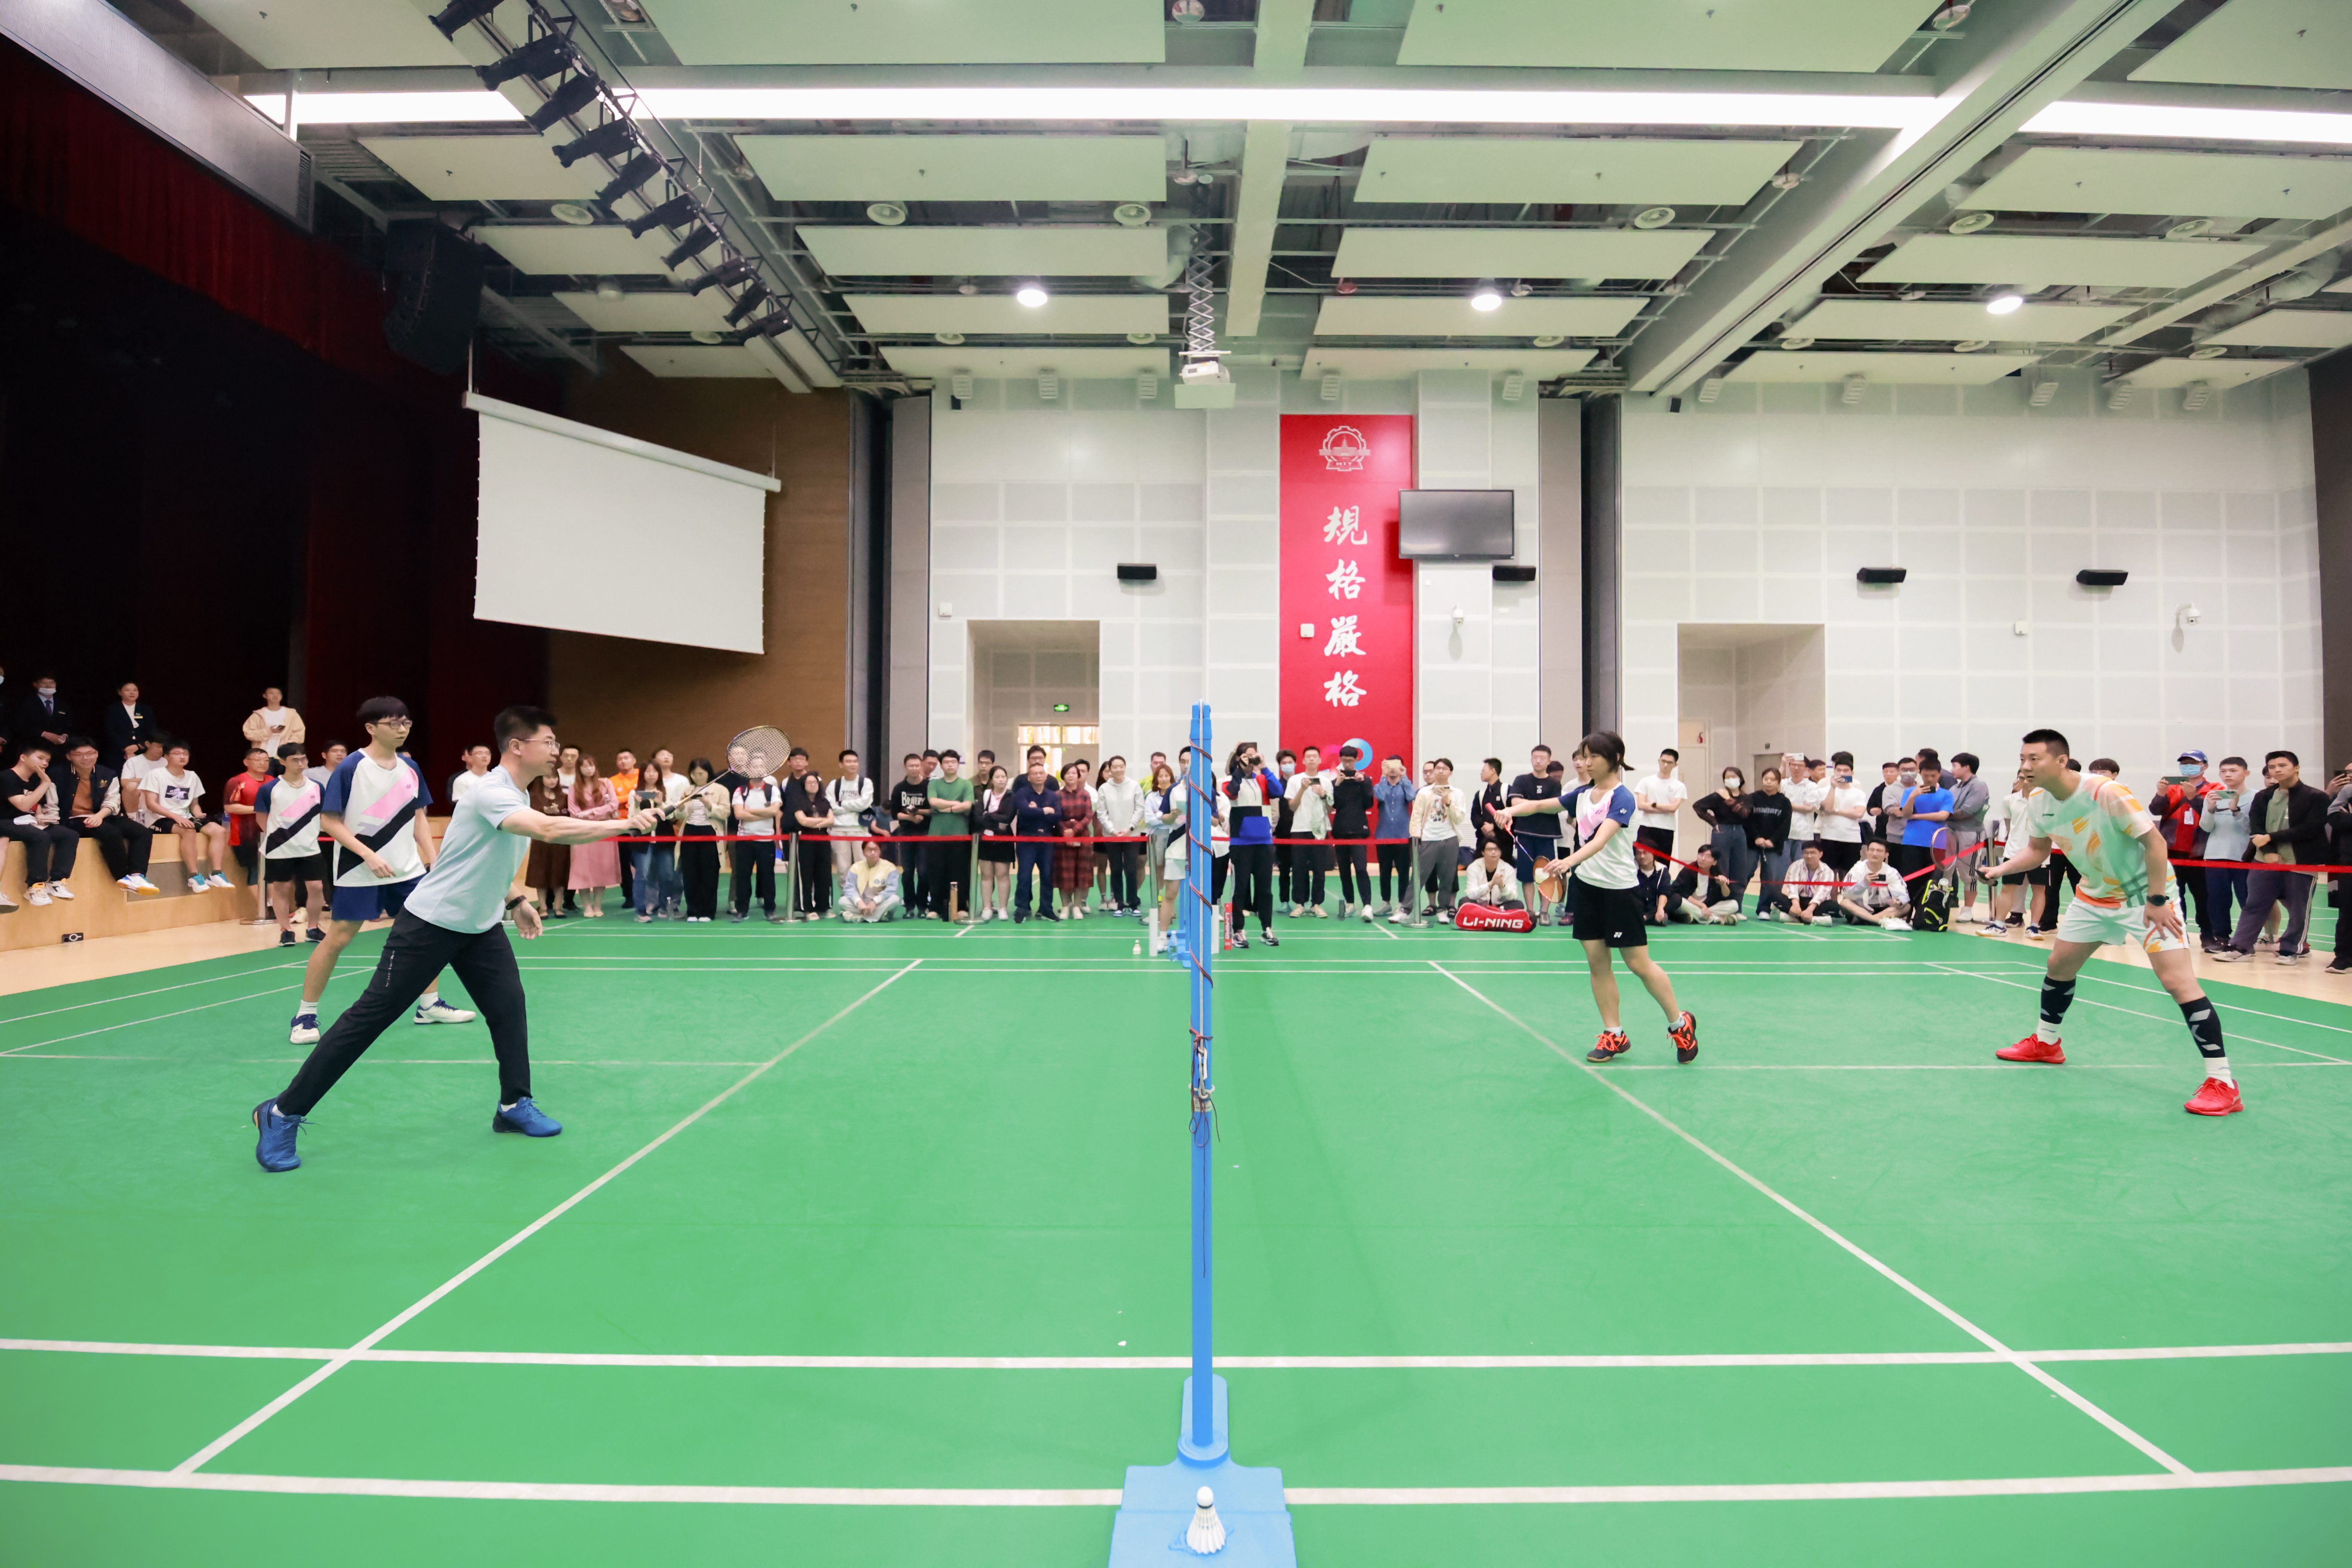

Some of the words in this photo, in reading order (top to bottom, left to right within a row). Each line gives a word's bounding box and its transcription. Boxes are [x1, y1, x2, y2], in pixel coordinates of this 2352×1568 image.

[1323, 505, 1368, 707] 規格嚴格
[1463, 916, 1524, 929] LI-NING
